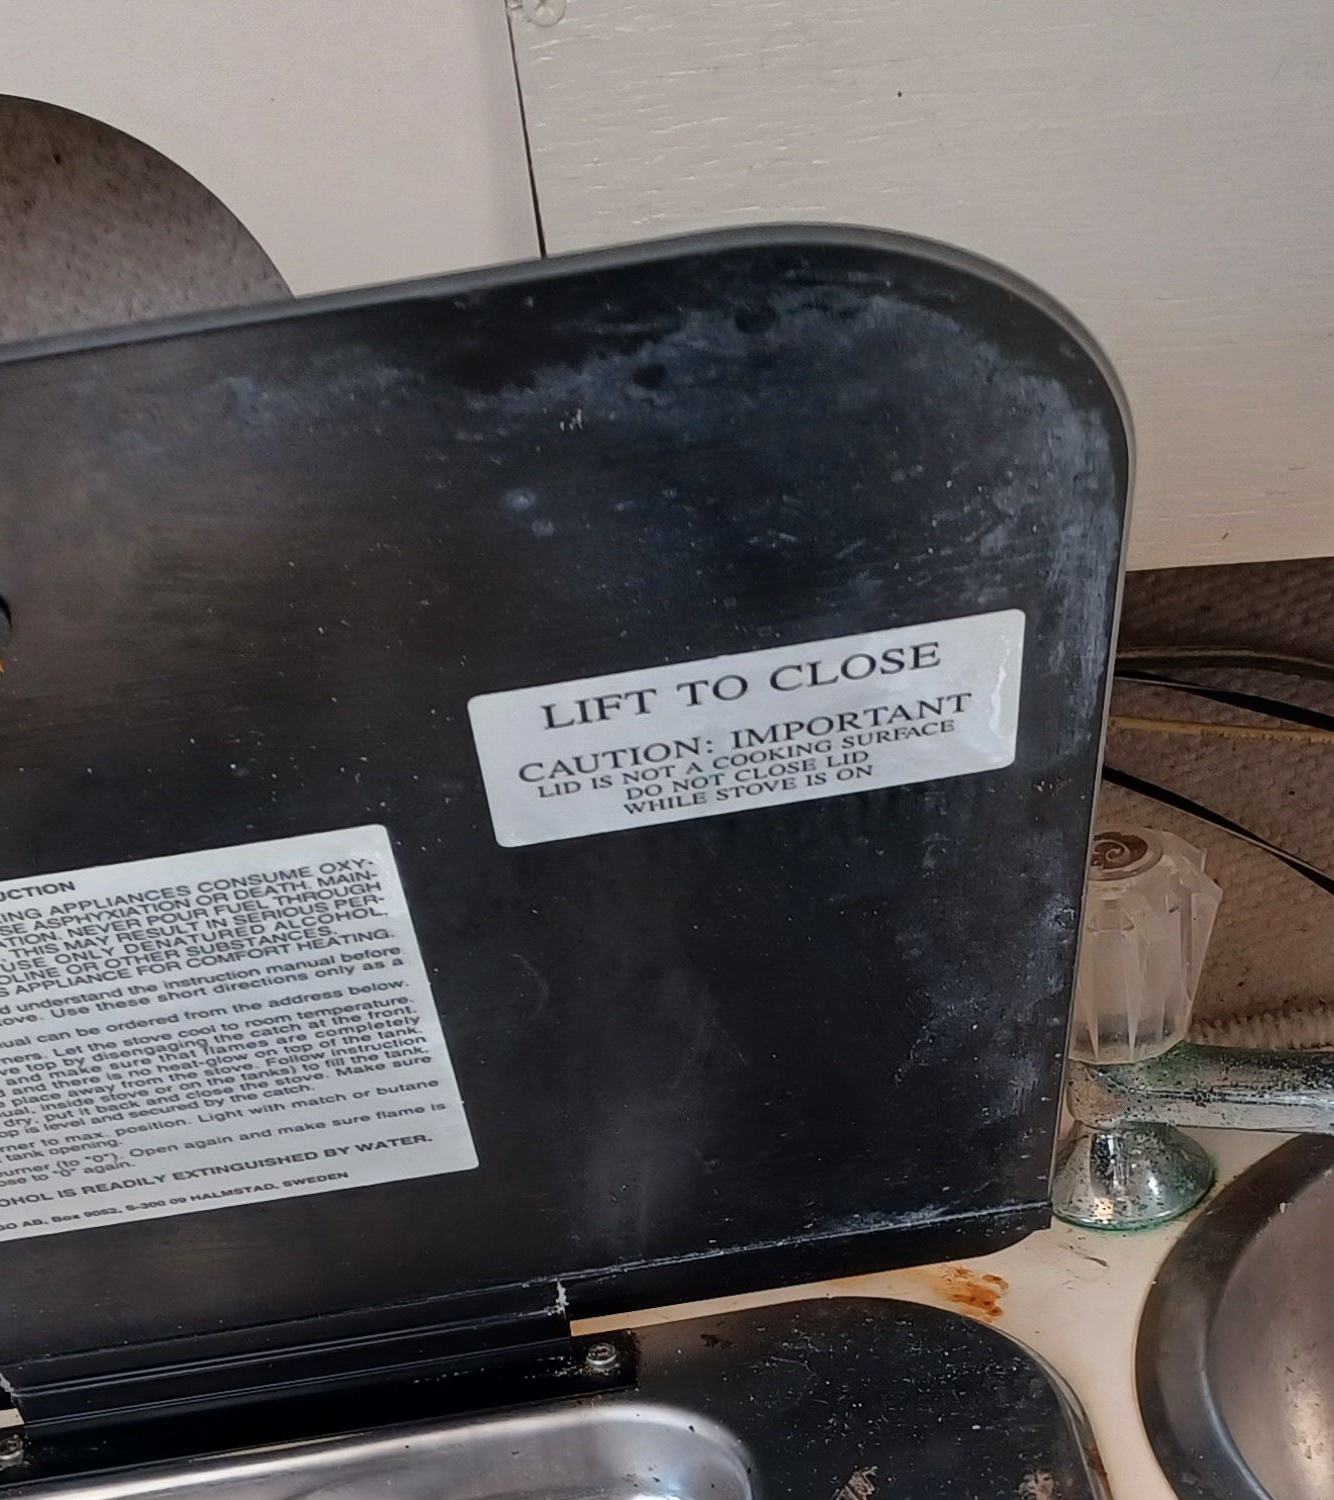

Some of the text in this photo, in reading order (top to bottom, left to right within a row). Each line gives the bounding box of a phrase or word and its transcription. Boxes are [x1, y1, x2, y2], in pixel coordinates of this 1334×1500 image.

[542, 642, 940, 729] LIFT TO CLOSE
[518, 693, 971, 782] CAUTION: IMPORTANT
[537, 719, 954, 798] LID IS NOT A COOKING SURFACE
[623, 764, 873, 814] WHILE STOVE IS ON
[625, 750, 869, 800] DO NOT CLOSE LID
[33, 898, 191, 930] ASPHYXIATION
[195, 891, 229, 906] OR
[232, 880, 311, 901] DEATH.
[316, 869, 377, 887] MAIN-
[50, 885, 191, 915] APPLIANCES
[197, 866, 312, 893] CONSUME
[318, 858, 373, 875] OXY-
[66, 917, 142, 938] NEVER
[145, 907, 209, 926] POUR
[213, 899, 269, 916] FUEL
[272, 881, 381, 906] THROUGH
[0, 956, 47, 973] USE
[53, 946, 114, 965] ONLY
[123, 924, 265, 954] DENATURED
[8, 942, 60, 959] THIS
[62, 935, 109, 951] MAY
[115, 921, 198, 943] RESULT
[205, 917, 228, 930] IN
[232, 901, 329, 926] SERIOUS
[333, 893, 384, 910] PER-
[65, 961, 100, 975] OR
[103, 948, 181, 969] OTHER
[185, 925, 336, 957] SUBSTANCES.
[15, 967, 131, 994] APPLIANCE
[135, 960, 182, 976] FOR
[185, 943, 290, 968] COMFORT
[296, 928, 394, 951] HEATING.
[16, 987, 123, 1012] understand
[126, 983, 158, 995] the
[163, 968, 261, 989] instruction
[265, 955, 336, 974] manual
[339, 946, 401, 963] before
[56, 1188, 77, 1198] IS
[80, 1174, 165, 1194] READILY
[172, 1151, 318, 1180] EXTINGUISHED
[323, 1145, 350, 1158] BY
[354, 1134, 432, 1152] WATER.
[282, 1171, 349, 1187] SWEDEN
